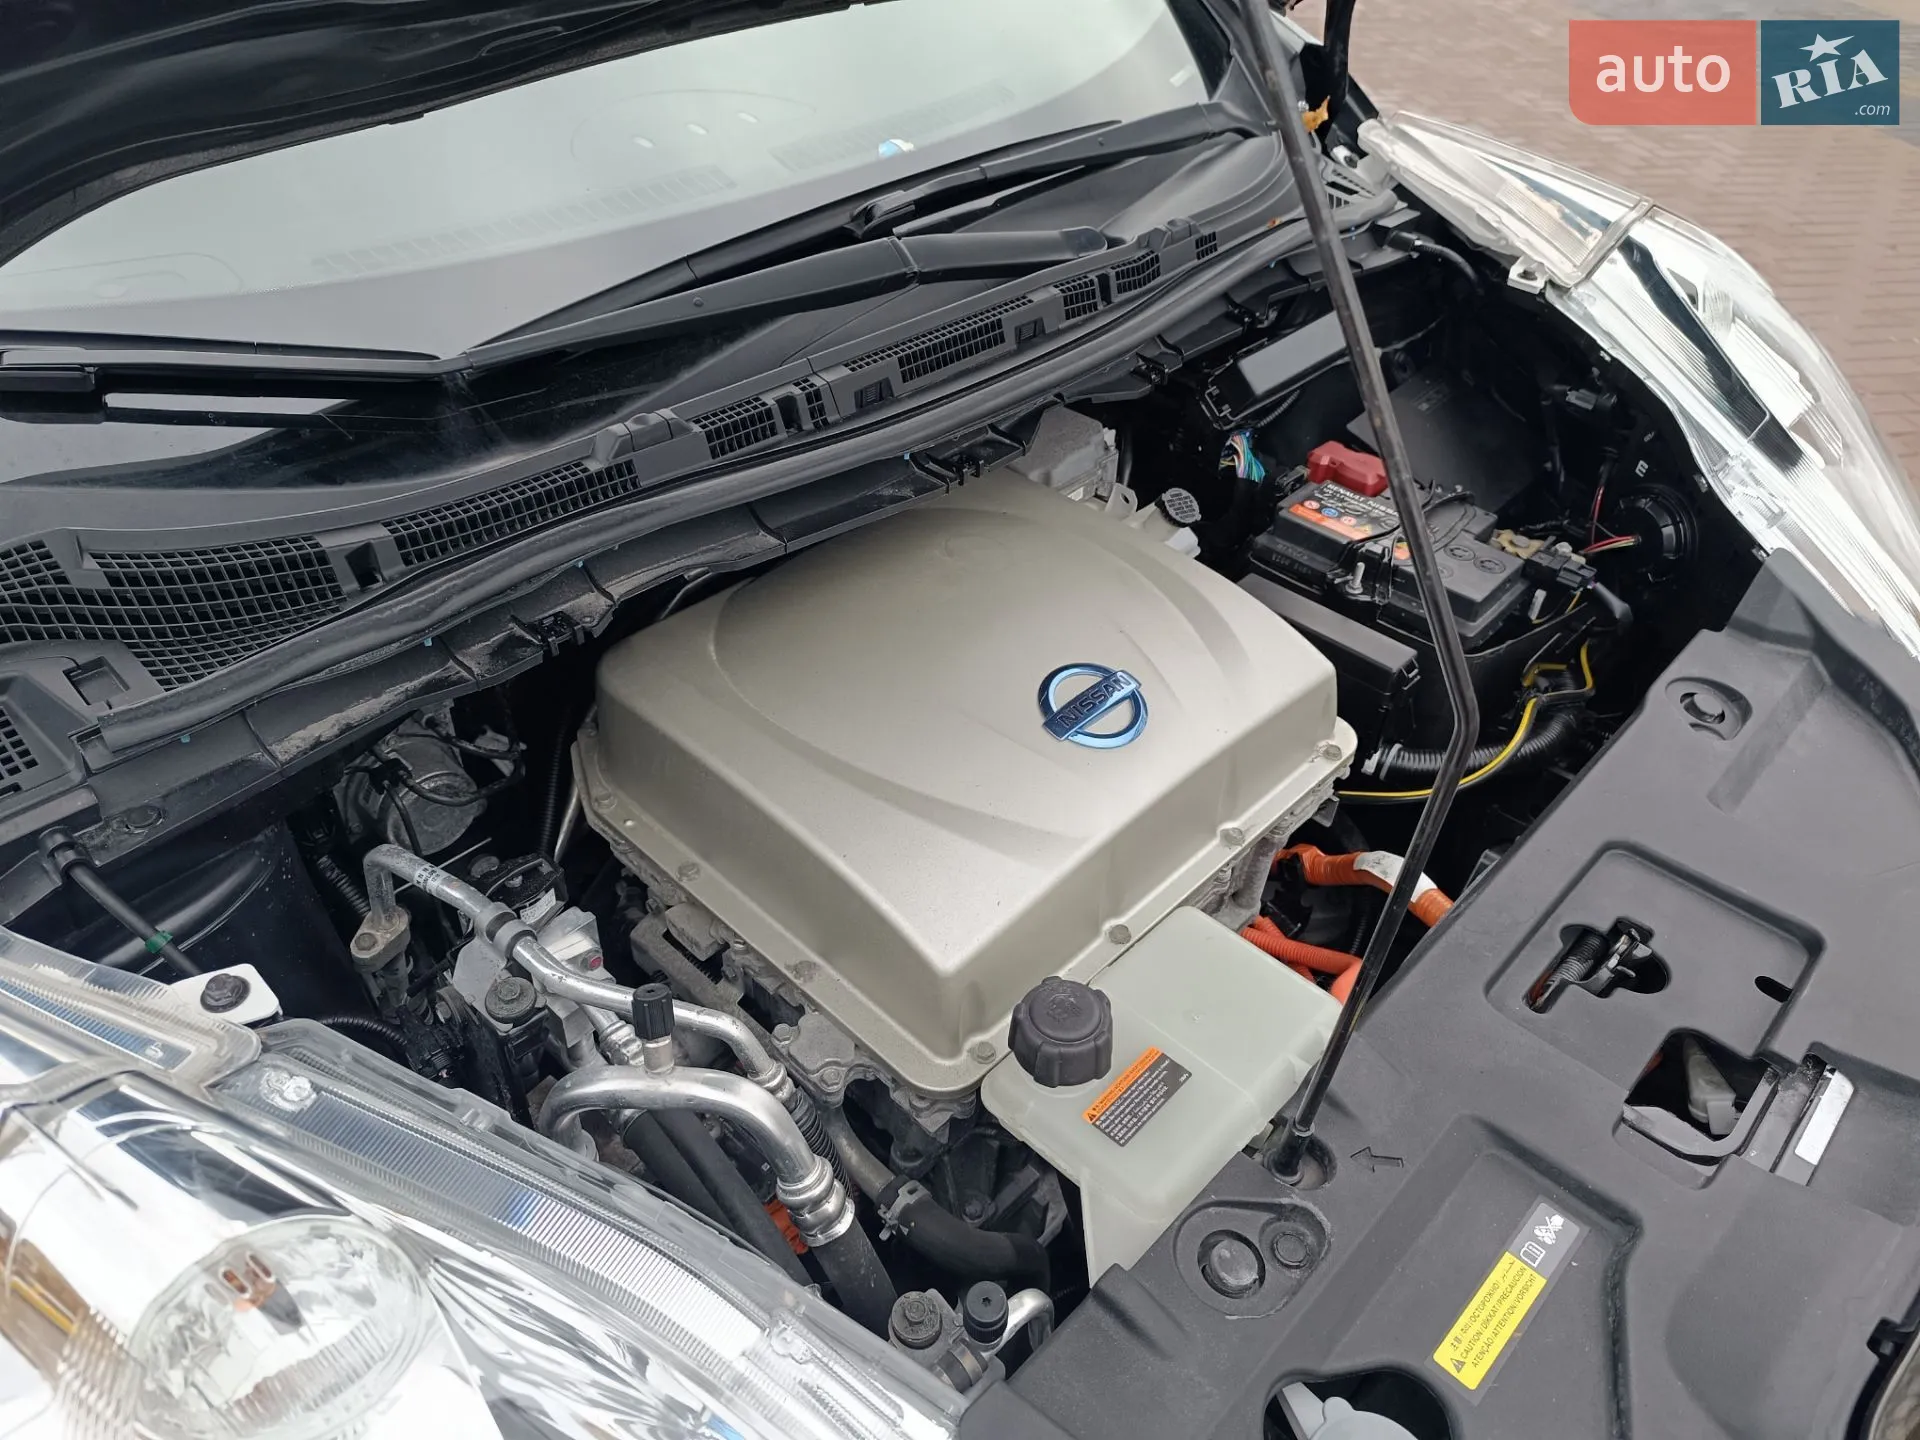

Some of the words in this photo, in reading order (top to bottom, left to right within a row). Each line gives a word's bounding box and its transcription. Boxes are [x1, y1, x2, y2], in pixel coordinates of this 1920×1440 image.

[1327, 483, 1366, 502] RENAULT
[1367, 500, 1399, 517] NISSA
[1056, 672, 1131, 729] NISSAN
